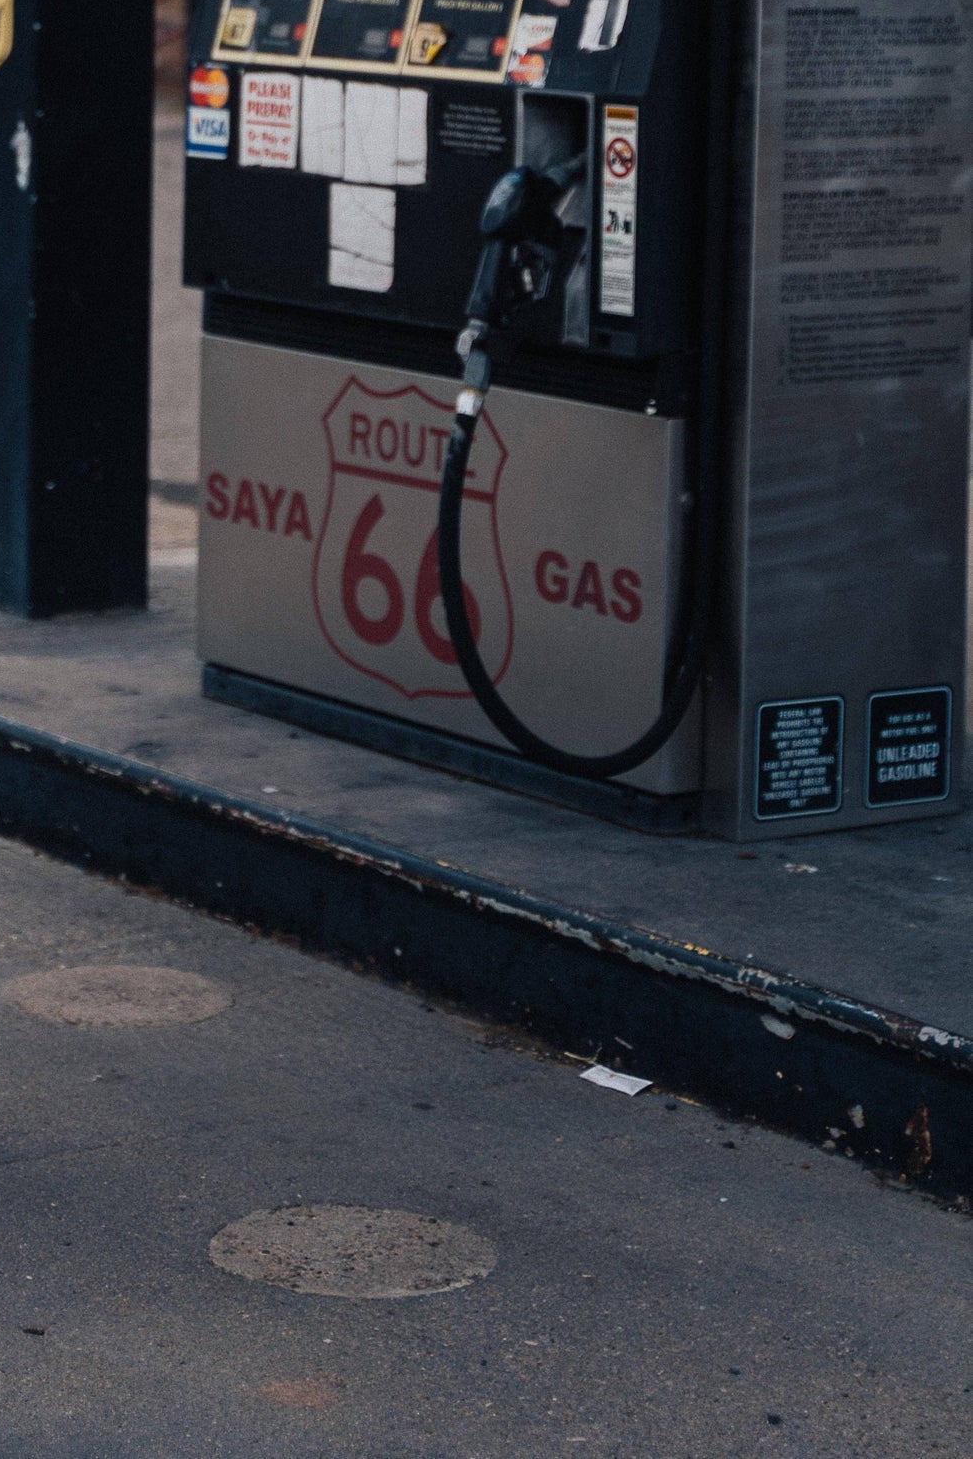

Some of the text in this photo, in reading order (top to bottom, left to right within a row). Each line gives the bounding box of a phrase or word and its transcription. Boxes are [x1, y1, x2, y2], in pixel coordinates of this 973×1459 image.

[196, 118, 227, 137] VISA
[246, 100, 293, 120] PREPAY
[349, 412, 475, 478] ROUT
[205, 471, 313, 542] SAYA
[340, 492, 482, 666] 66
[534, 550, 642, 624] GAS
[877, 741, 940, 764] UNLEADED
[878, 760, 938, 783] GASOLINE
